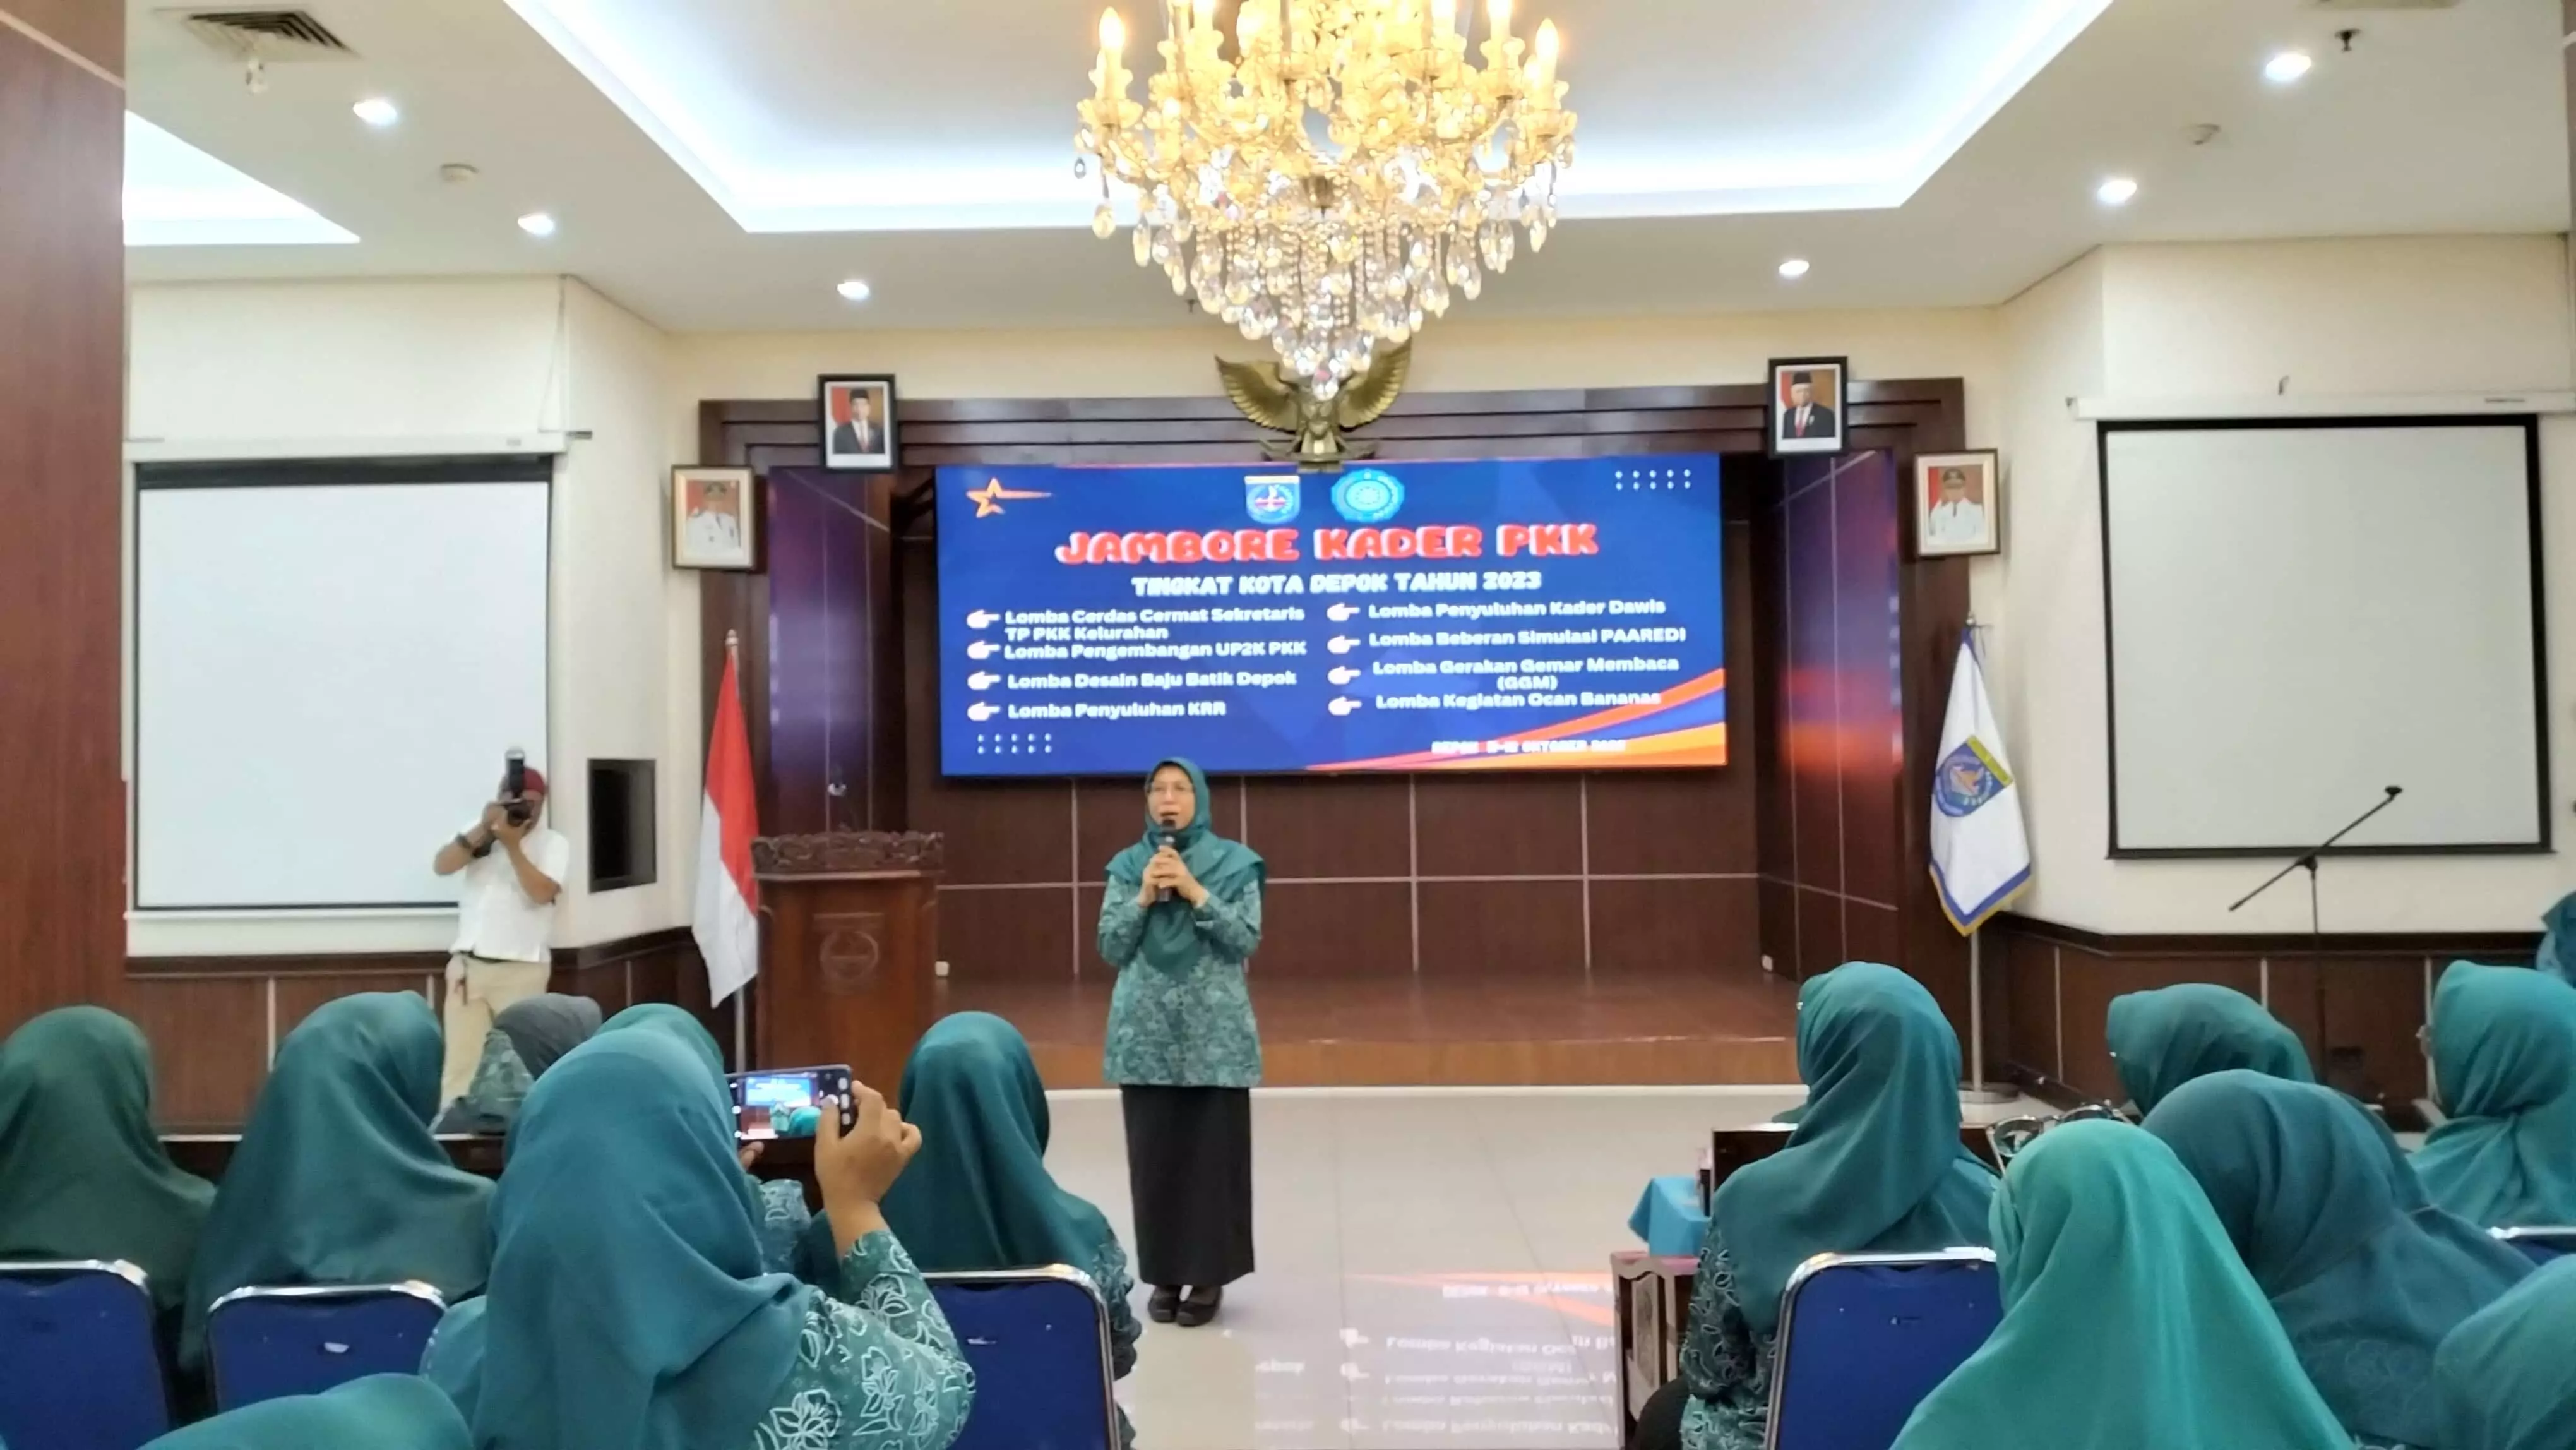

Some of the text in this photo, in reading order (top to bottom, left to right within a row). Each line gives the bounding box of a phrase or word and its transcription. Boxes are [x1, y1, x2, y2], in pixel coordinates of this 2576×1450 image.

[1054, 524, 1599, 563] JAMBORE KADER PKK
[1131, 570, 1542, 596] TINGKAT KOTA DEPOK TAHUN 2023
[1005, 606, 1305, 625] Lomba Cerdas Cermat Sekretaris
[1368, 599, 1666, 620] Lomba Penyuluhan Kader Dawis
[1005, 625, 1169, 641] TP PKK Kelurahan
[1369, 627, 1686, 647] Lomba Beberan Simulasi PAAREDI
[1004, 640, 1307, 661] Lomba Pengembangan UP2K PKK
[1373, 656, 1679, 675] Lomba Gerakan Gemar Membaca
[1007, 670, 1297, 690] Lomba Desain Baju Batik Depok
[1496, 675, 1558, 692] (GGM)
[1376, 691, 1662, 710] Lomba Kegiatan Ocan Bananas
[1008, 702, 1226, 720] Lomba Penyuluhan KRR
